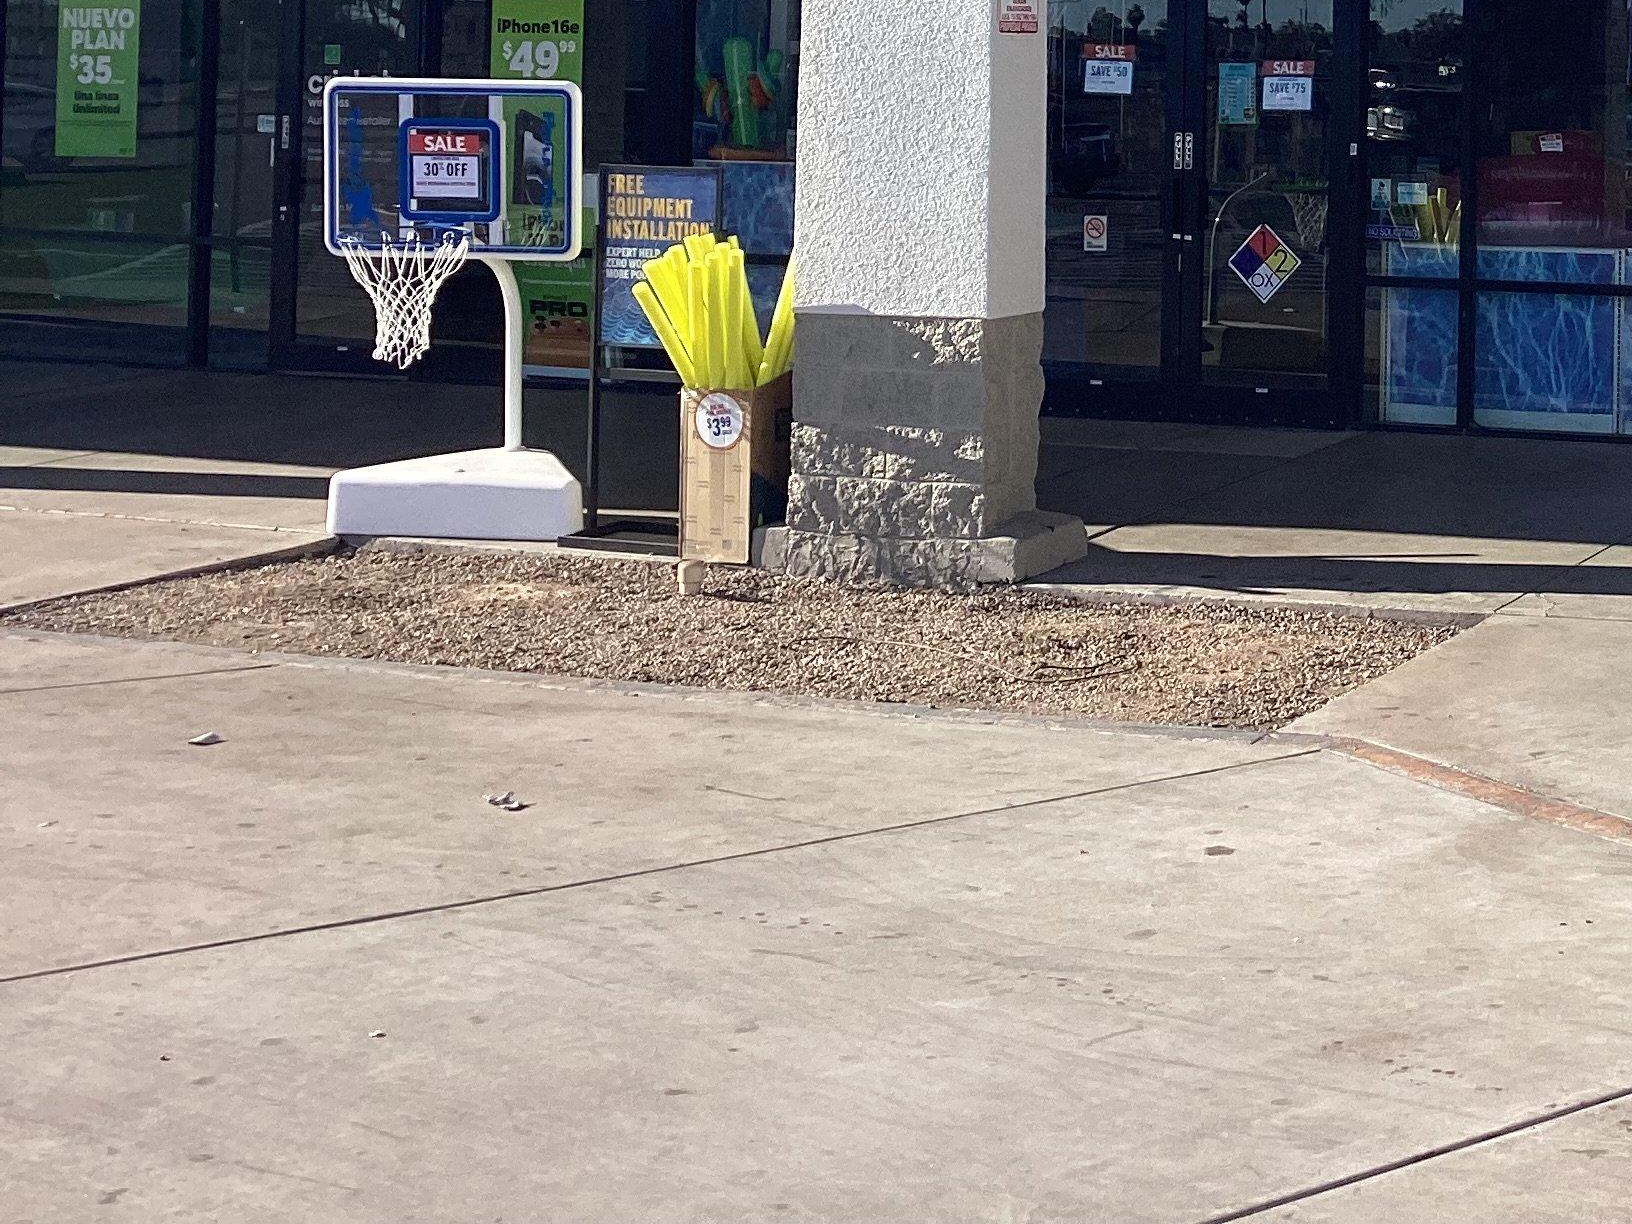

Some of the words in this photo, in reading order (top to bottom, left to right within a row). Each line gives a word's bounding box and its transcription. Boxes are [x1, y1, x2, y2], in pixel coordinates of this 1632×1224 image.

[62, 7, 136, 29] NUEVO
[71, 29, 126, 50] PLAN
[1095, 45, 1126, 59] SALE
[69, 53, 113, 85] $35
[1091, 65, 1112, 77] SAVE
[1272, 60, 1305, 74] SALE
[1269, 82, 1290, 94] SAVE
[424, 135, 467, 152] SALE
[446, 162, 469, 177] OFF
[607, 173, 645, 195] FREE
[607, 196, 694, 219] EQUIPMENT
[606, 247, 638, 257] EXPERT
[1260, 230, 1268, 258] 1
[606, 257, 628, 268] ZERO
[1274, 248, 1288, 273] 2
[1251, 272, 1274, 288] OX
[529, 299, 588, 317] PRO
